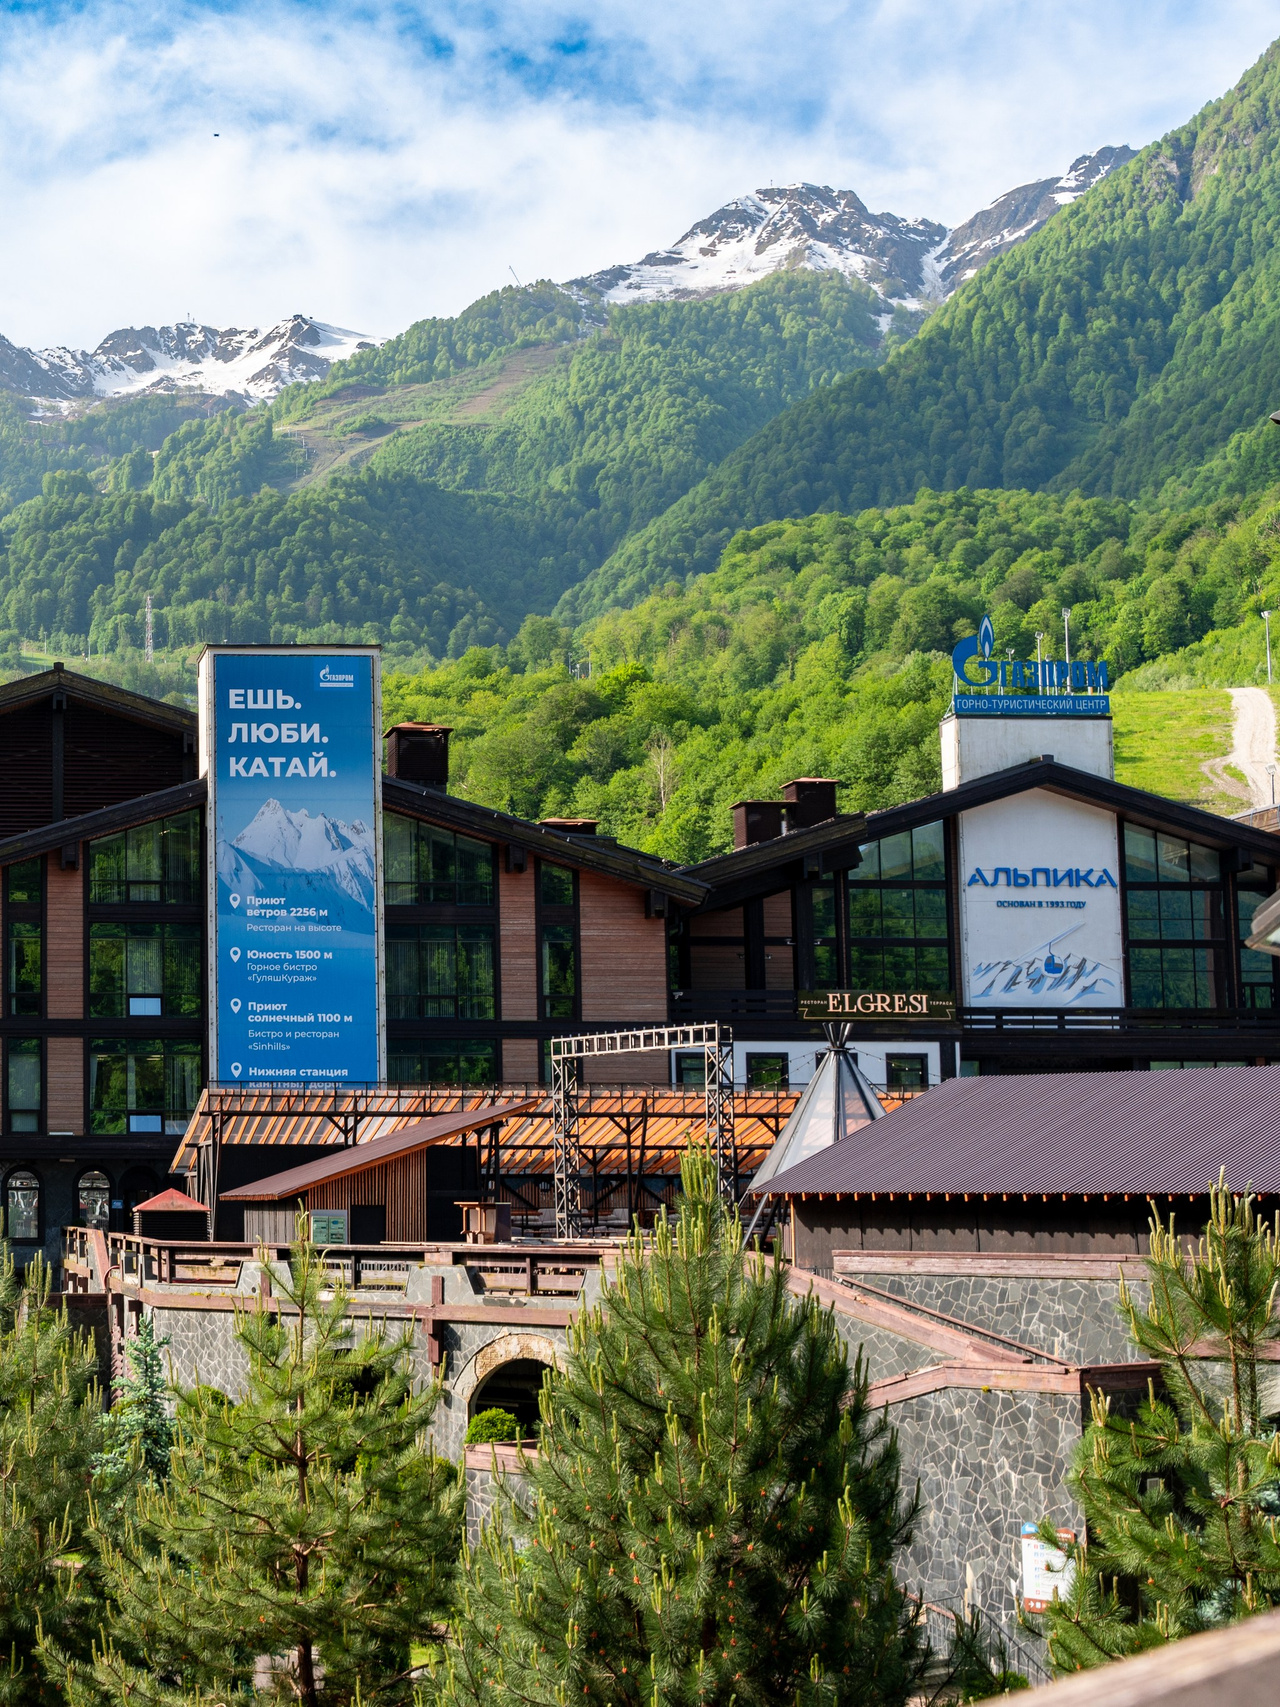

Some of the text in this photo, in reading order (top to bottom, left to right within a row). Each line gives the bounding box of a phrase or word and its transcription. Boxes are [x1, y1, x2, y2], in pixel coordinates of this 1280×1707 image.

[229, 689, 302, 709] ЕШЬ.
[957, 699, 1107, 711] ГОРНО-ТУРИСТИЧЕСКИЙ ЦЕНТР
[228, 723, 329, 744] ЛЮБИ.
[229, 752, 337, 778] КАТАЙ.
[967, 867, 1118, 888] АЛЬПИКА
[246, 895, 286, 907] Приют
[996, 900, 1035, 908] ОСНОВАН
[1066, 901, 1086, 909] ГОДУ
[246, 907, 287, 918] ветров
[290, 907, 317, 917] 2256
[246, 923, 291, 934] Ресторан
[247, 950, 293, 959] Юность
[295, 950, 321, 959] 1500
[247, 963, 318, 973] Горное бистро
[247, 974, 317, 984] «ГуляшКураж»
[248, 1002, 287, 1013] Приют
[826, 993, 929, 1014] ELGRESI
[248, 1013, 314, 1023] солнечный
[317, 1014, 341, 1023] 1100
[248, 1030, 283, 1039] Бистро
[295, 1031, 340, 1039] ресторан
[248, 1042, 290, 1051] «Sinhills»
[249, 1067, 348, 1077] Нижняя станция
